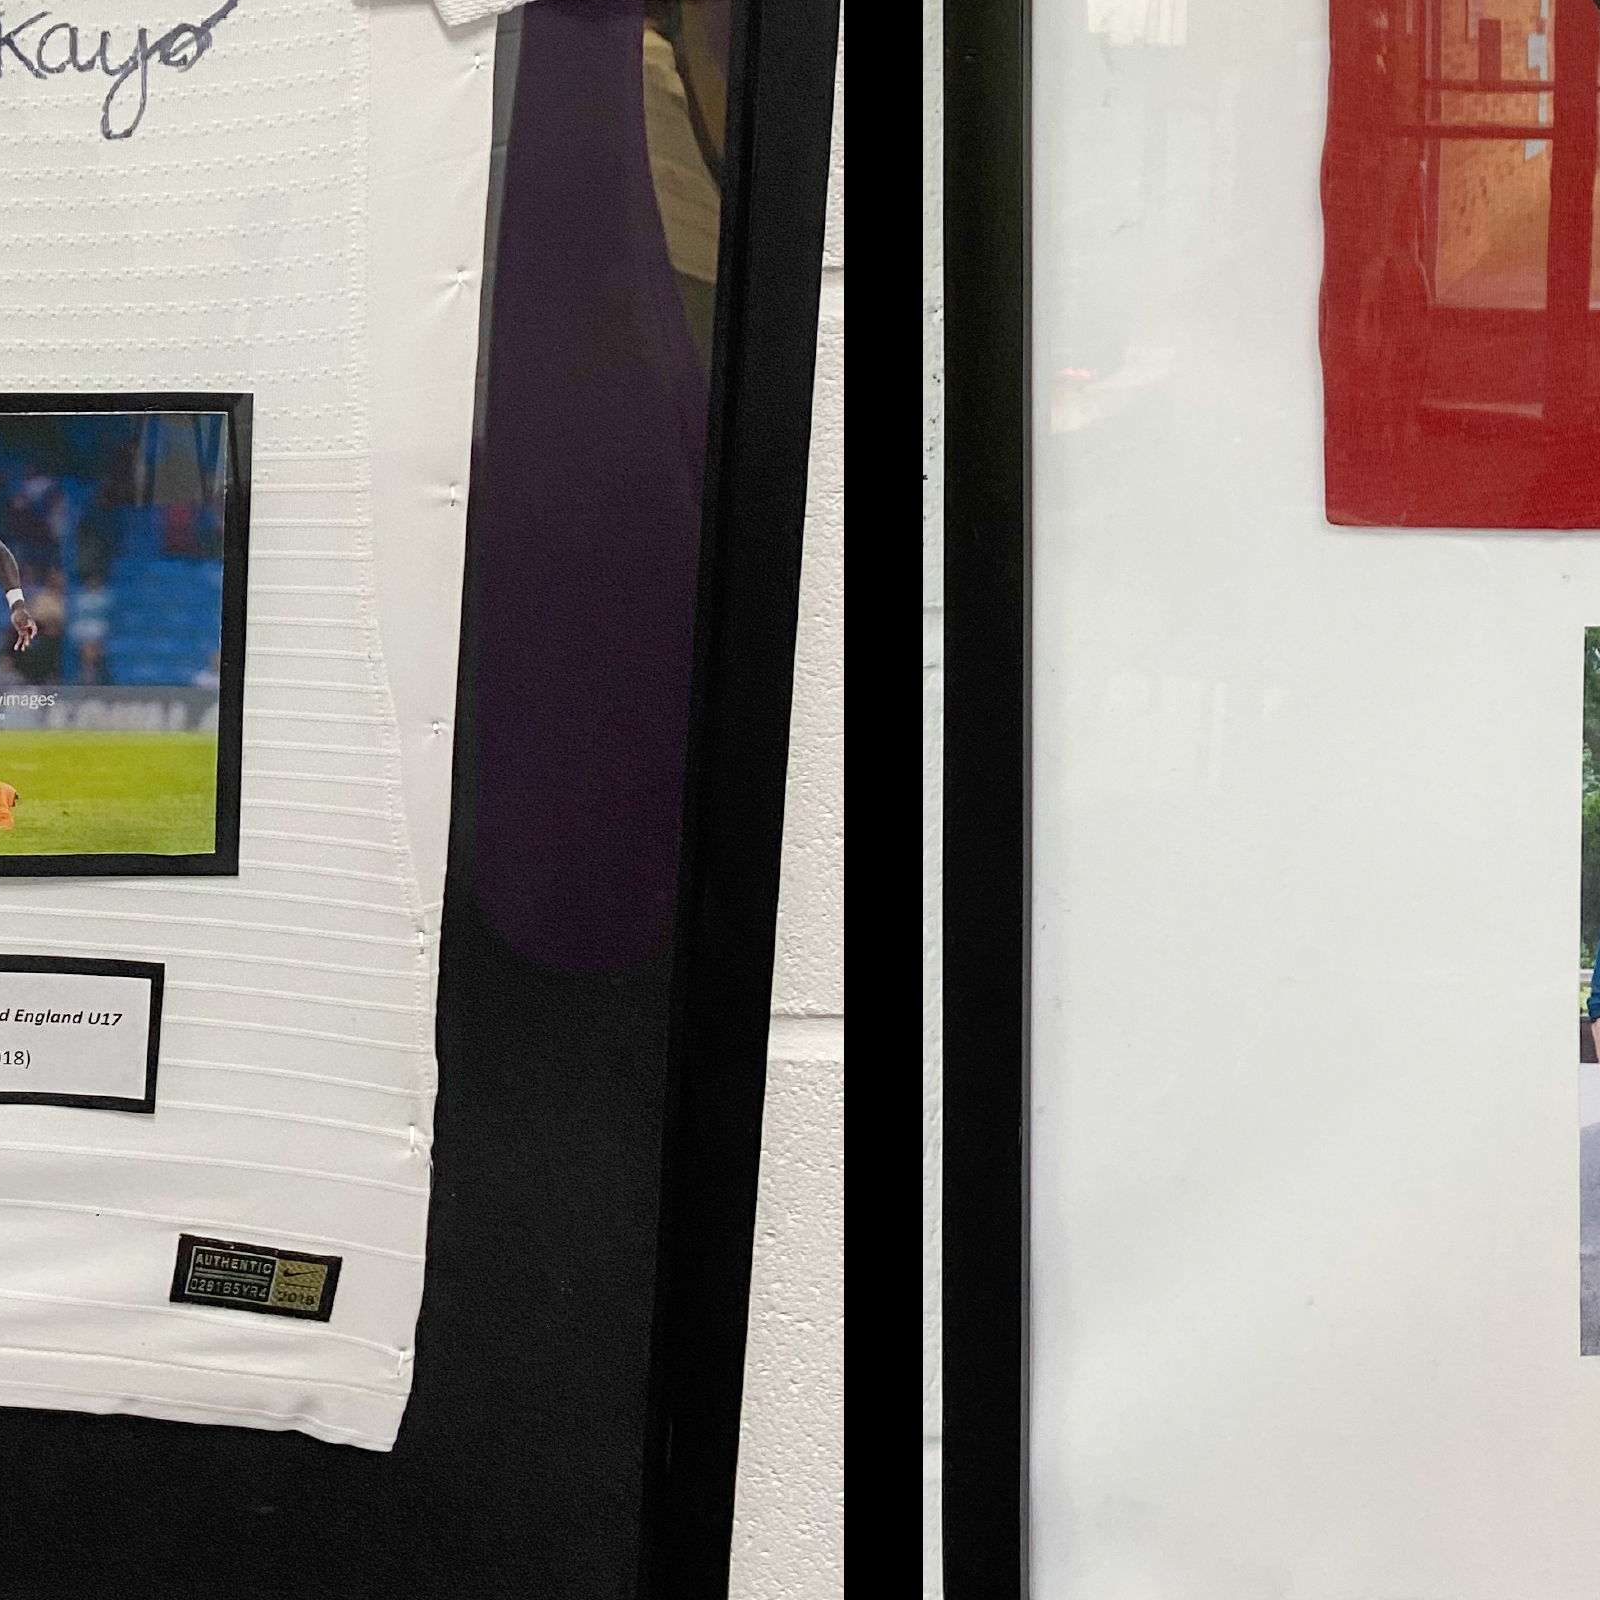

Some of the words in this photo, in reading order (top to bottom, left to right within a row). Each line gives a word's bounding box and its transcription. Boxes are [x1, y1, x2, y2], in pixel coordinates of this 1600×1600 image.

[14, 1008, 84, 1026] England
[87, 1012, 123, 1026] U17
[195, 1253, 273, 1275] AUTHENTIC
[277, 1290, 316, 1307] 2018
